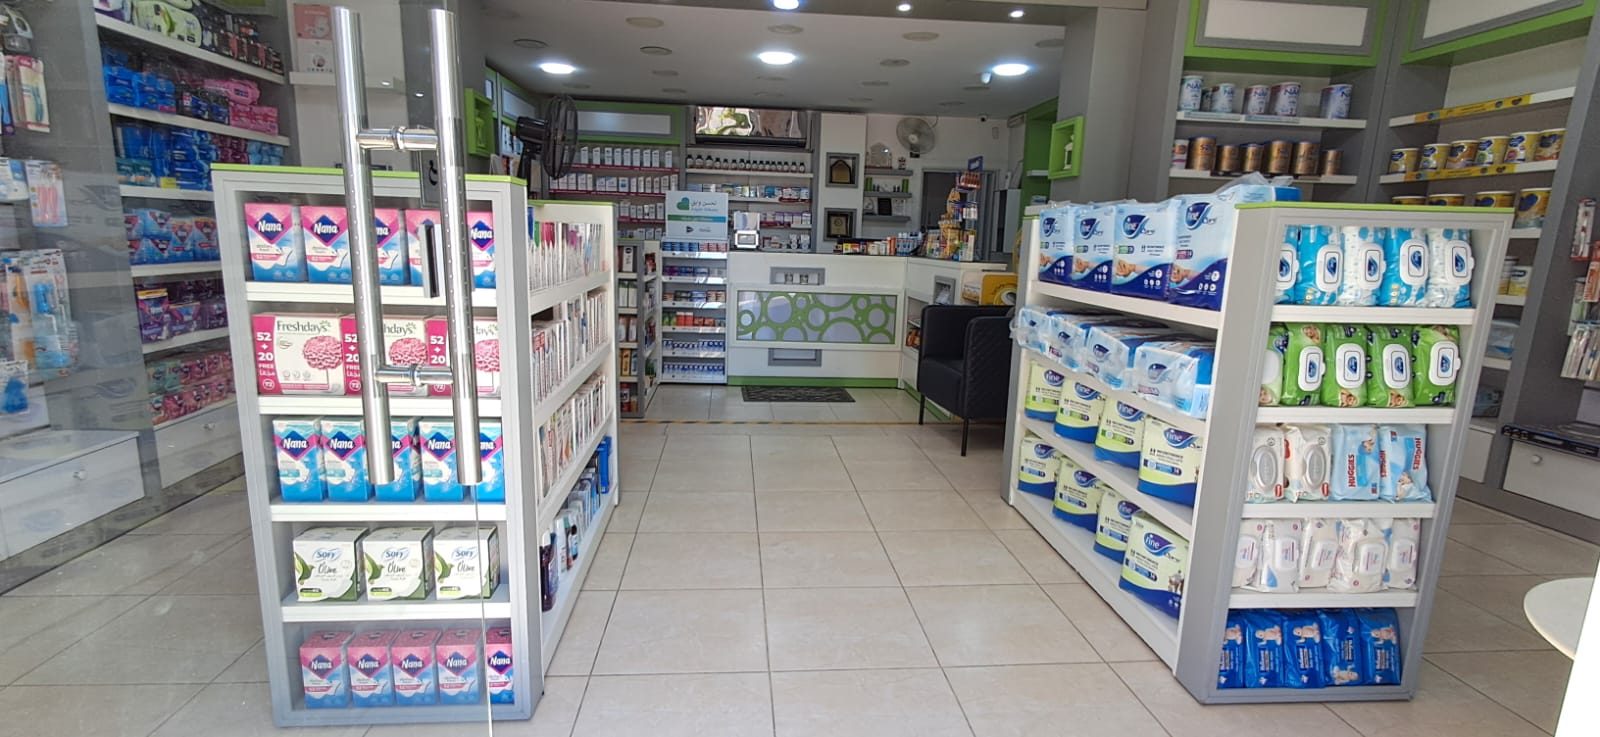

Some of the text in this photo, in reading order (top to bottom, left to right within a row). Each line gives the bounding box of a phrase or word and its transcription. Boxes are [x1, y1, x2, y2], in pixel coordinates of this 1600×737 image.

[258, 220, 282, 232] Nana
[314, 222, 339, 235] Nana
[472, 228, 492, 240] Nana
[277, 320, 328, 334] Freshdays
[383, 323, 413, 336] hdays
[256, 332, 272, 342] 52
[344, 334, 358, 342] 52
[430, 336, 444, 344] 52
[258, 352, 274, 361] 20
[346, 354, 360, 362] 20
[431, 356, 446, 364] 20
[1046, 370, 1060, 382] fine
[1166, 429, 1182, 442] fine
[283, 439, 307, 449] Nana
[330, 439, 354, 450] Nana
[428, 439, 452, 450] Nana
[1412, 438, 1422, 470] HUGGIES
[1348, 454, 1356, 487] HUGGIES
[1074, 471, 1088, 483] fine
[1118, 501, 1132, 514] fine
[1146, 534, 1160, 549] fine
[312, 660, 332, 670] Nana
[358, 658, 380, 668] Nana
[402, 658, 424, 669] Nana
[446, 656, 468, 668] Nana
[490, 655, 511, 666] Nana
